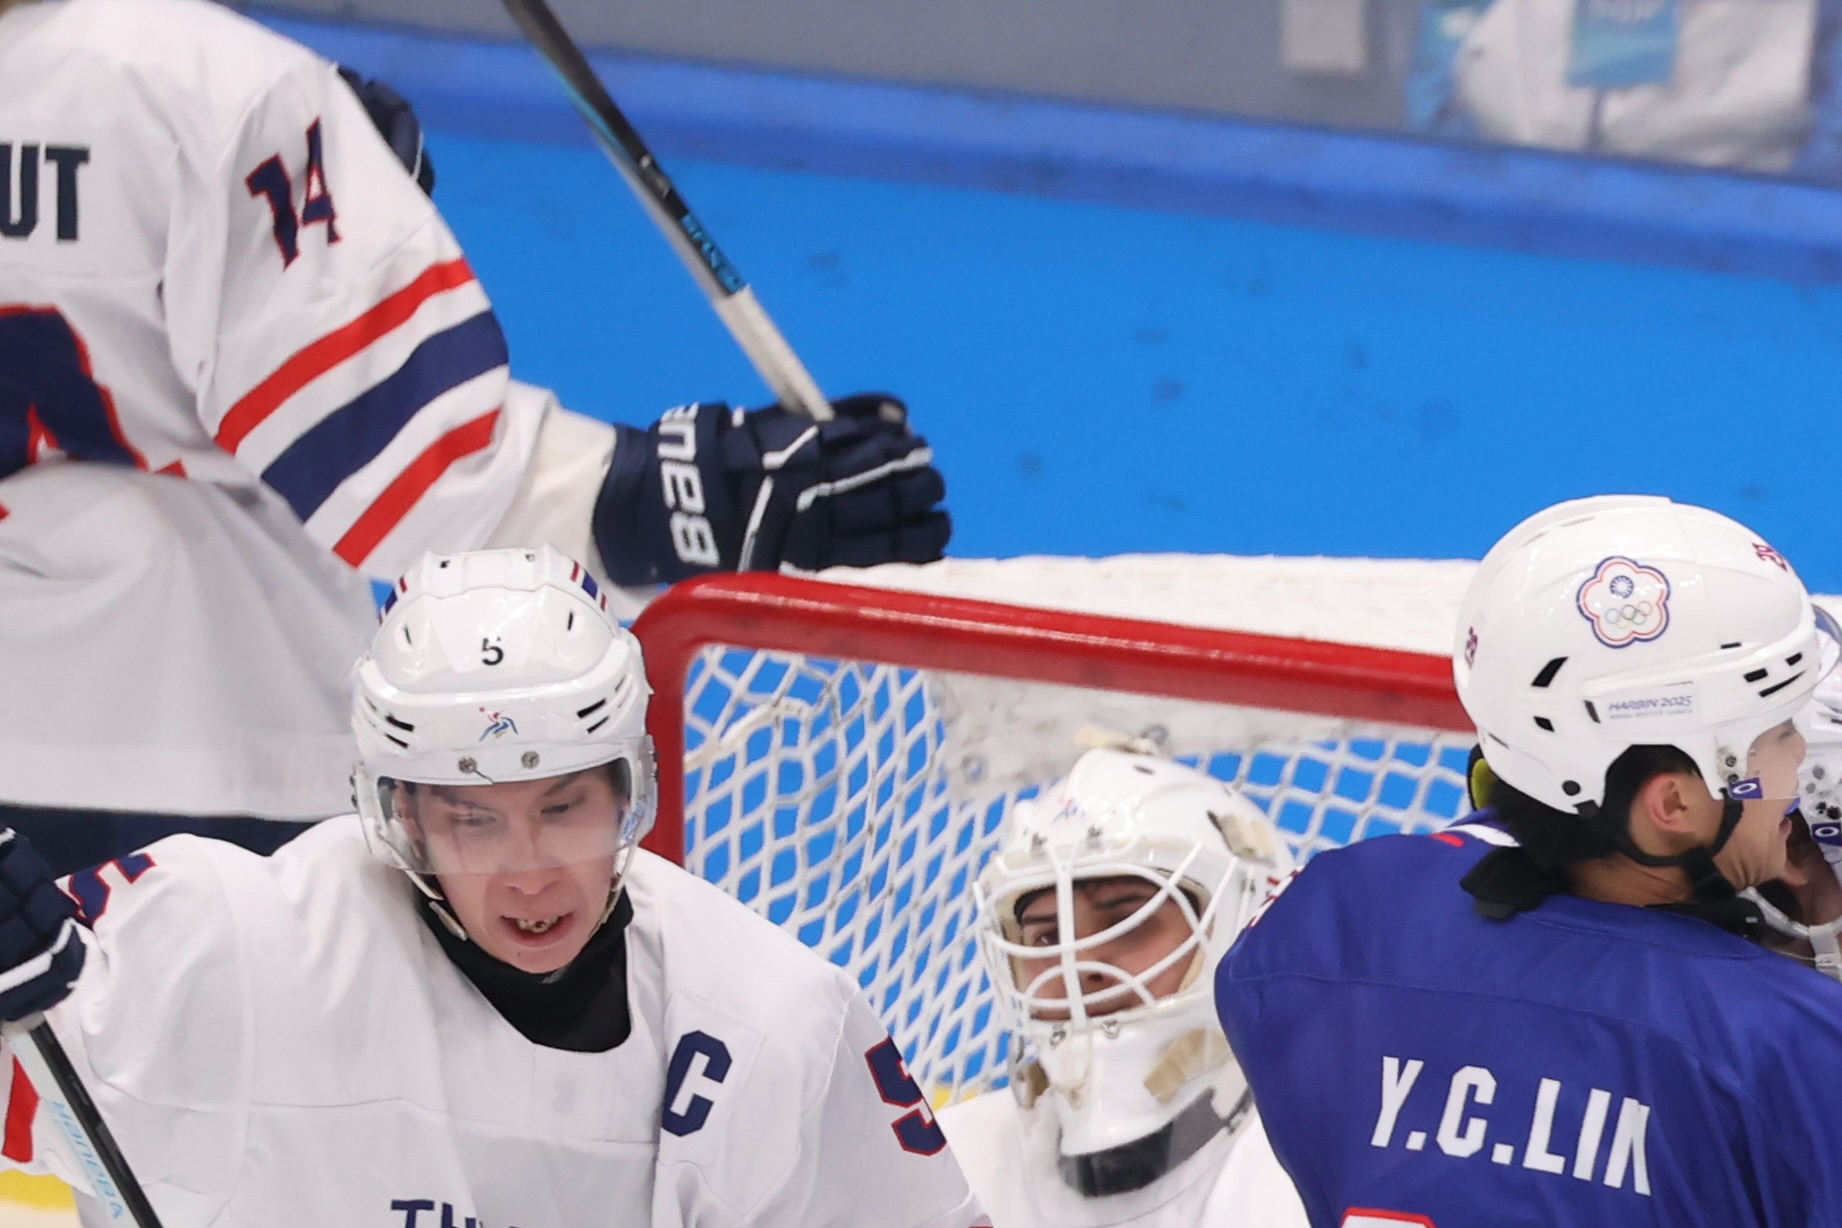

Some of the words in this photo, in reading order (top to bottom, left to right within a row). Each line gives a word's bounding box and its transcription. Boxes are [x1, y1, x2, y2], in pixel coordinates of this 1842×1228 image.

[246, 116, 341, 270] 14
[481, 638, 504, 667] 5
[1660, 695, 1694, 708] 2025
[661, 1029, 733, 1138] C
